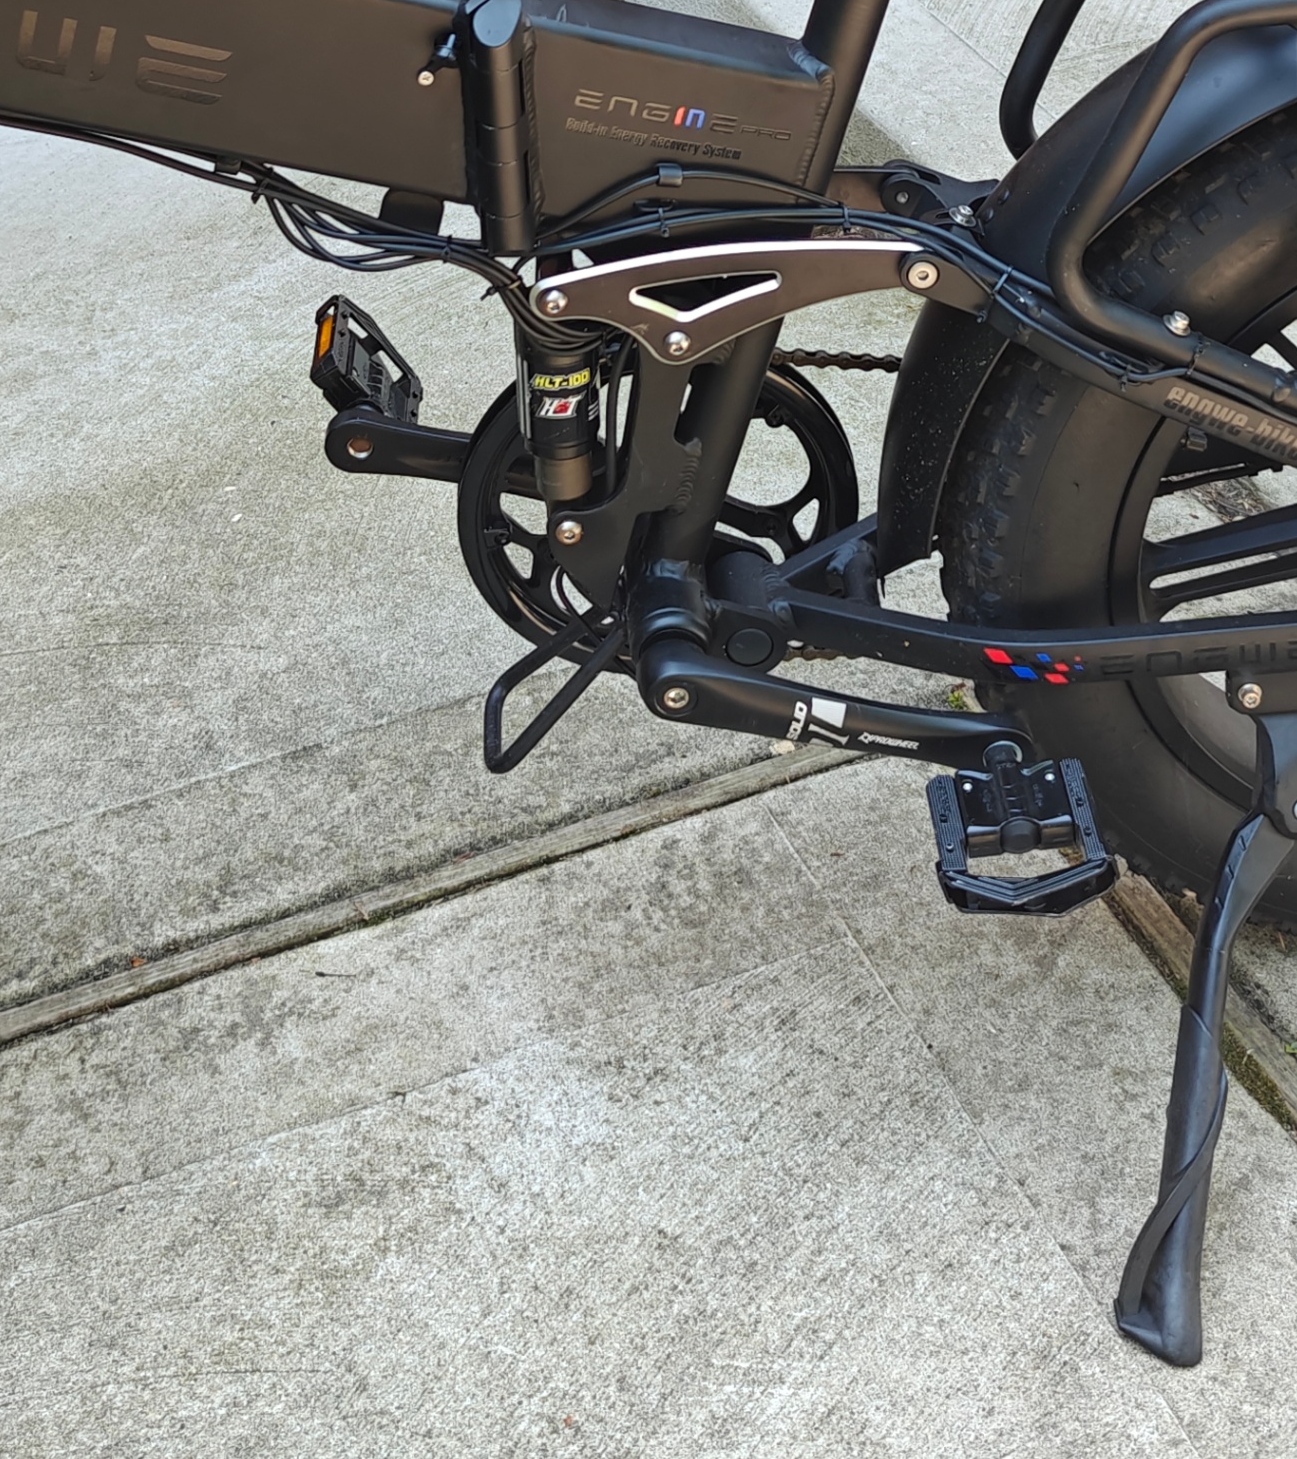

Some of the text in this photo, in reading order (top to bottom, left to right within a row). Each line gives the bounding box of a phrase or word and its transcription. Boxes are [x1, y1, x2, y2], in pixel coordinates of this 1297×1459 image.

[574, 88, 792, 142] ENGINE PRO
[565, 117, 742, 160] Build-in Energy Recovery System
[532, 369, 591, 389] HLT-100
[785, 700, 809, 741] SOLID
